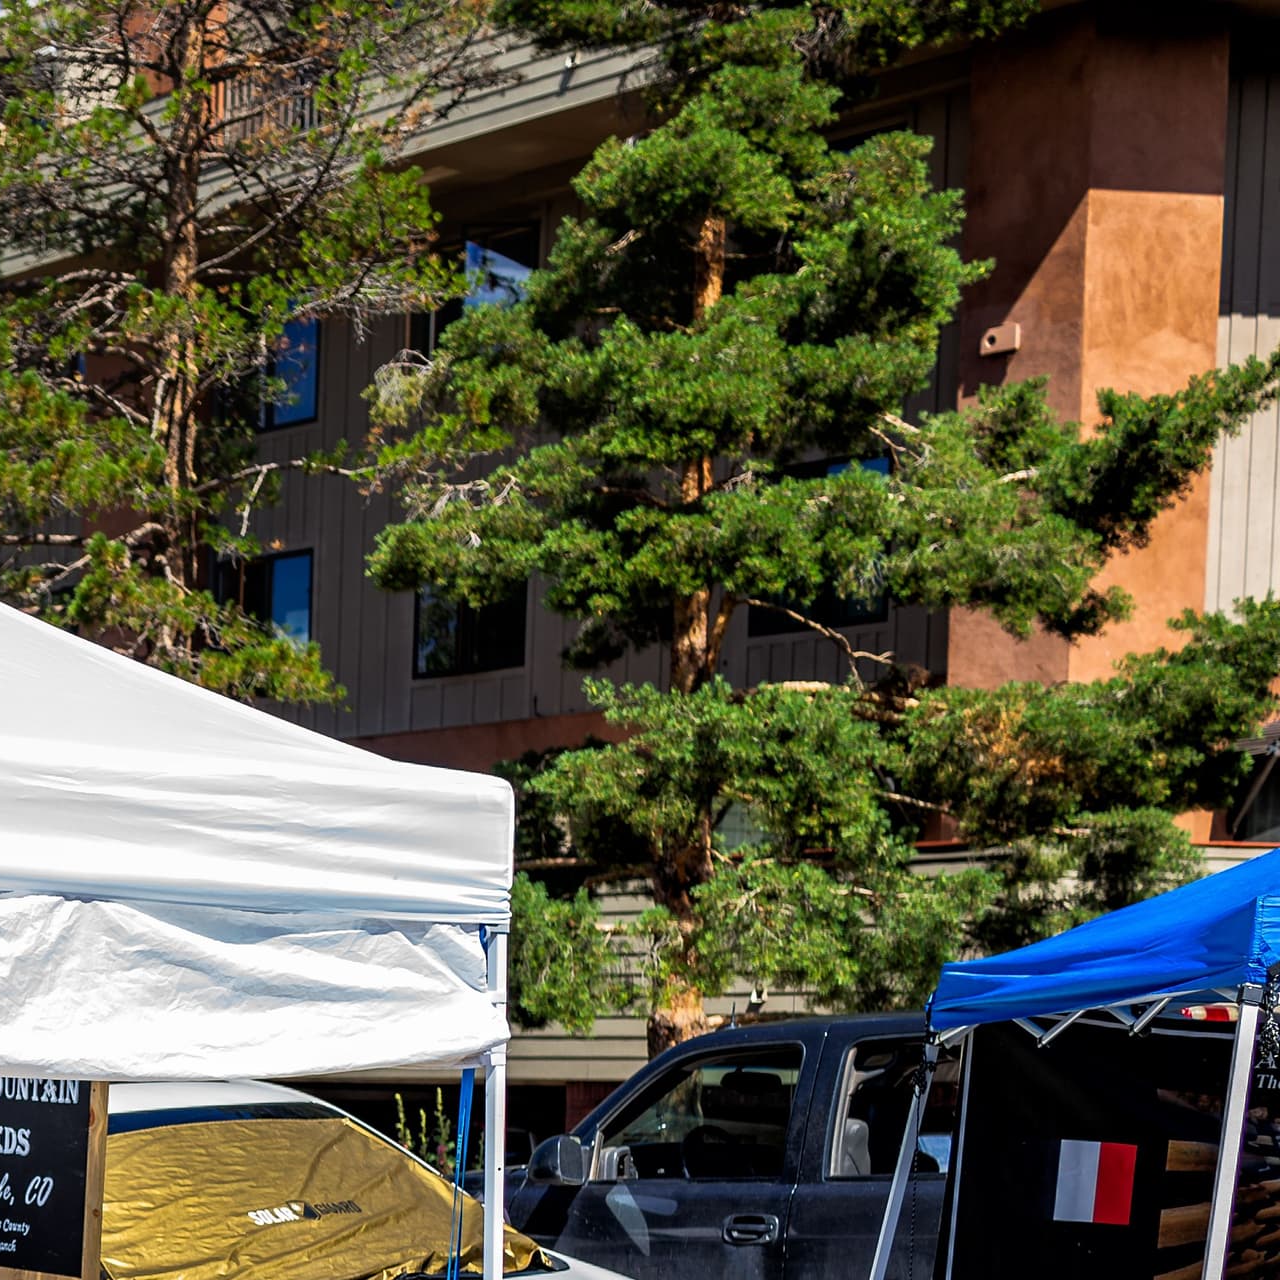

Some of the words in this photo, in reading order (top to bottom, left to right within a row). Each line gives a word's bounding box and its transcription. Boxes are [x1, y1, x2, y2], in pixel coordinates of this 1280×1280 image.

[25, 1176, 54, 1207] CO
[248, 1206, 300, 1226] SOLAR
[3, 1219, 30, 1237] County
